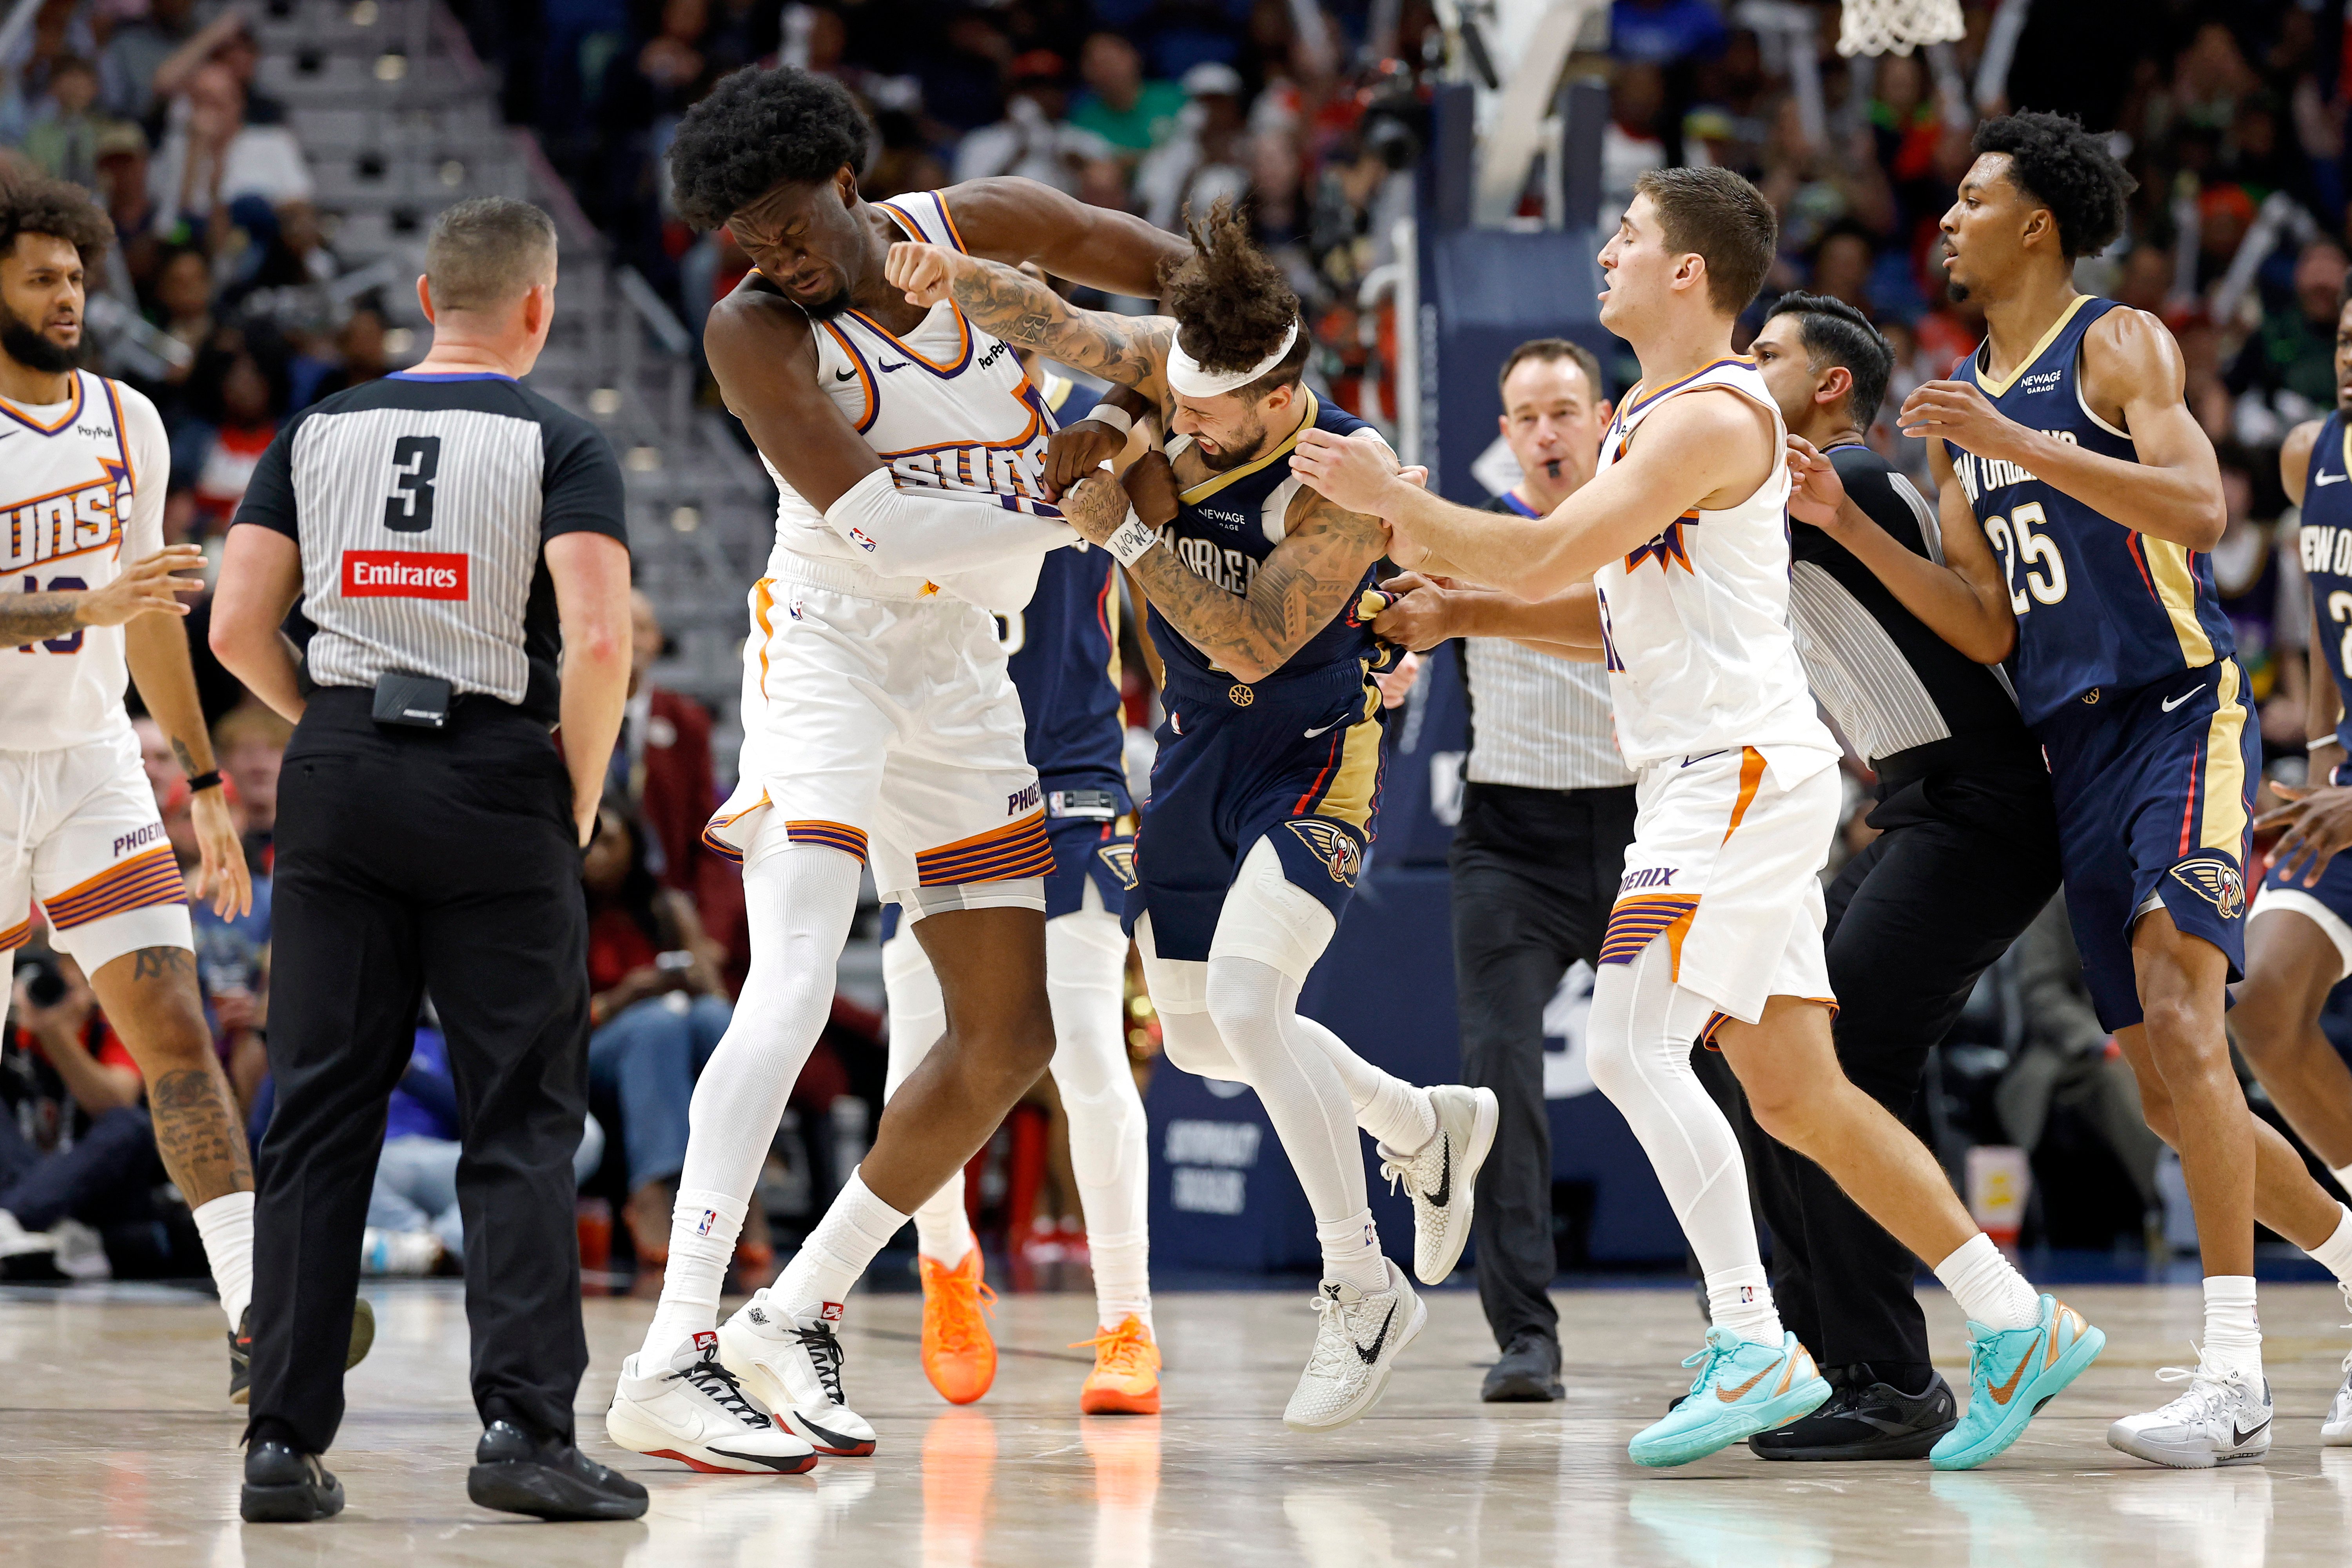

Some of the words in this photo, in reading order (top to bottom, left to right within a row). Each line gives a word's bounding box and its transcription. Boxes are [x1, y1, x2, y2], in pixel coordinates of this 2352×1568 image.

[2020, 370, 2061, 388] NEWAGE
[2027, 384, 2054, 394] GARAGE
[77, 425, 113, 440] PayPal
[383, 435, 441, 533] 3
[1198, 508, 1245, 524] NEWAGE
[0, 485, 112, 572] UNS
[1219, 523, 1239, 531] AGE
[1984, 501, 2068, 616] 25
[354, 561, 457, 588] Emirates
[1618, 867, 1680, 897] OENIX
[826, 1305, 841, 1314] NIKE
[699, 1334, 713, 1343] NIKE
